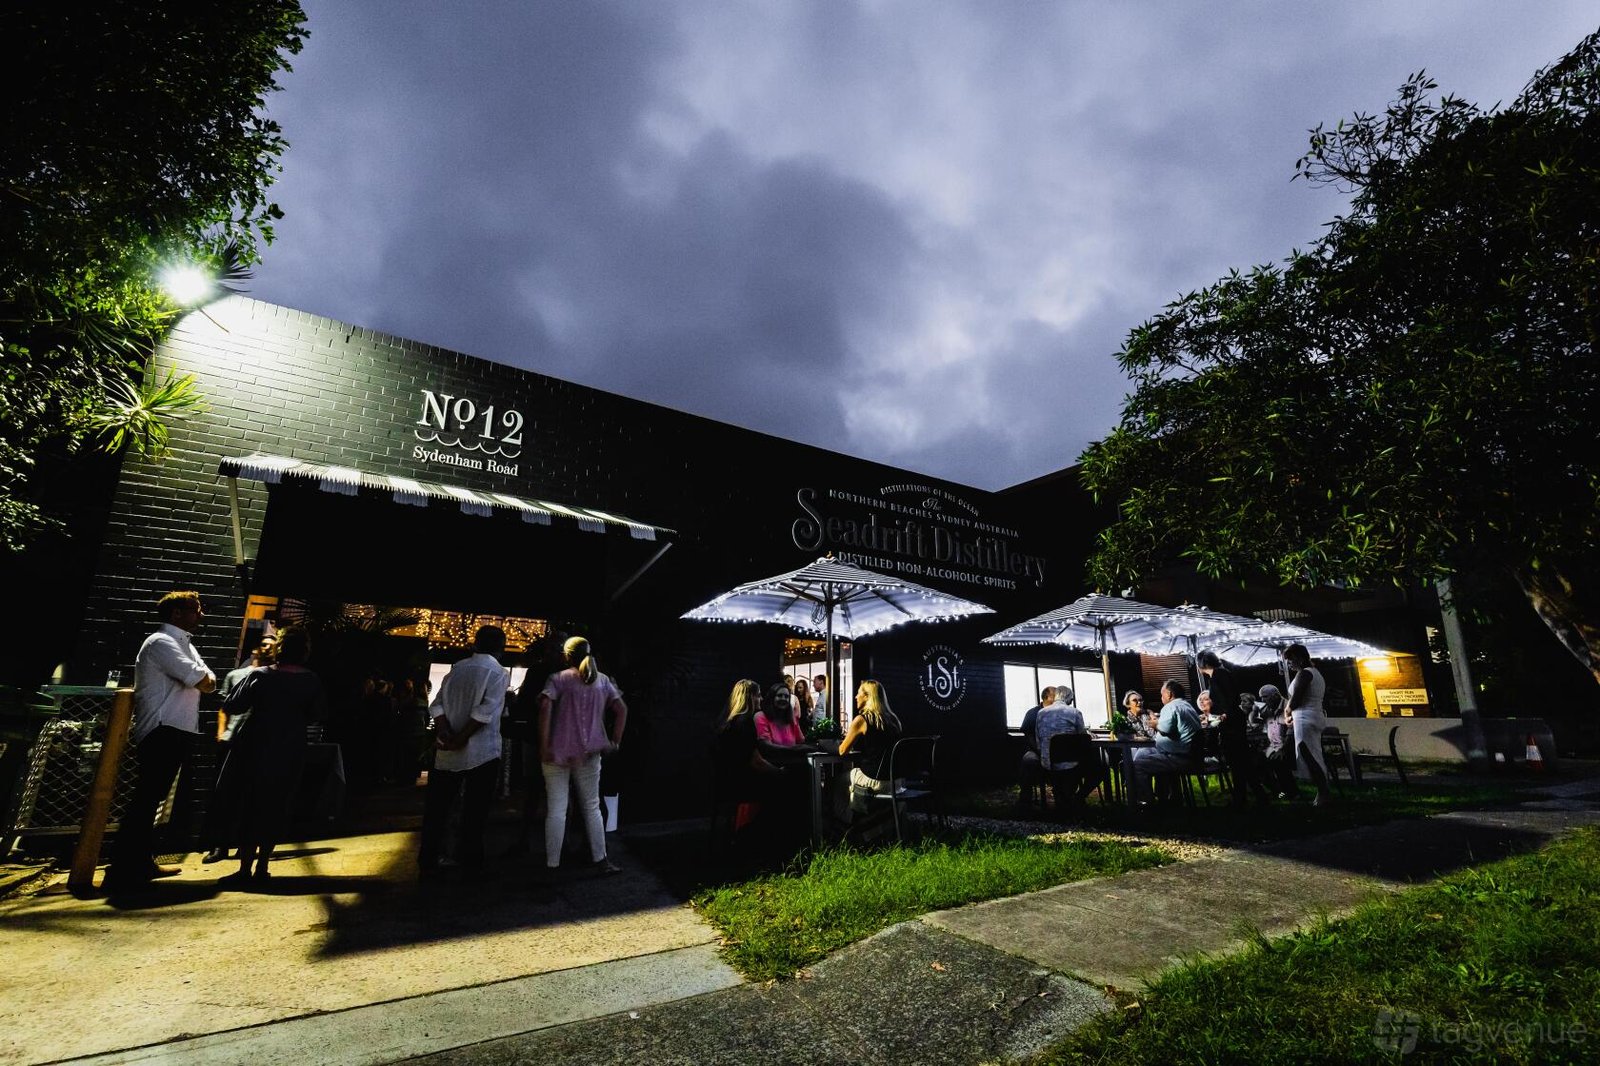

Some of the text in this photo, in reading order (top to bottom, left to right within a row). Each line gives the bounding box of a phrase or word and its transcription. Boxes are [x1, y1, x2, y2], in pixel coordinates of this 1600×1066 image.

[412, 445, 519, 476] Sydenham Road
[828, 488, 1019, 539] NORTHERN BEACHES SYDNEY AUSTRALIA
[880, 483, 980, 517] DISTILLATIONS OF THE OCEAN
[922, 497, 942, 511] The
[791, 487, 1048, 588] Seadrift Distillery
[838, 551, 1017, 591] DISTILLED NON-ALCOHOLIC SPIRITS
